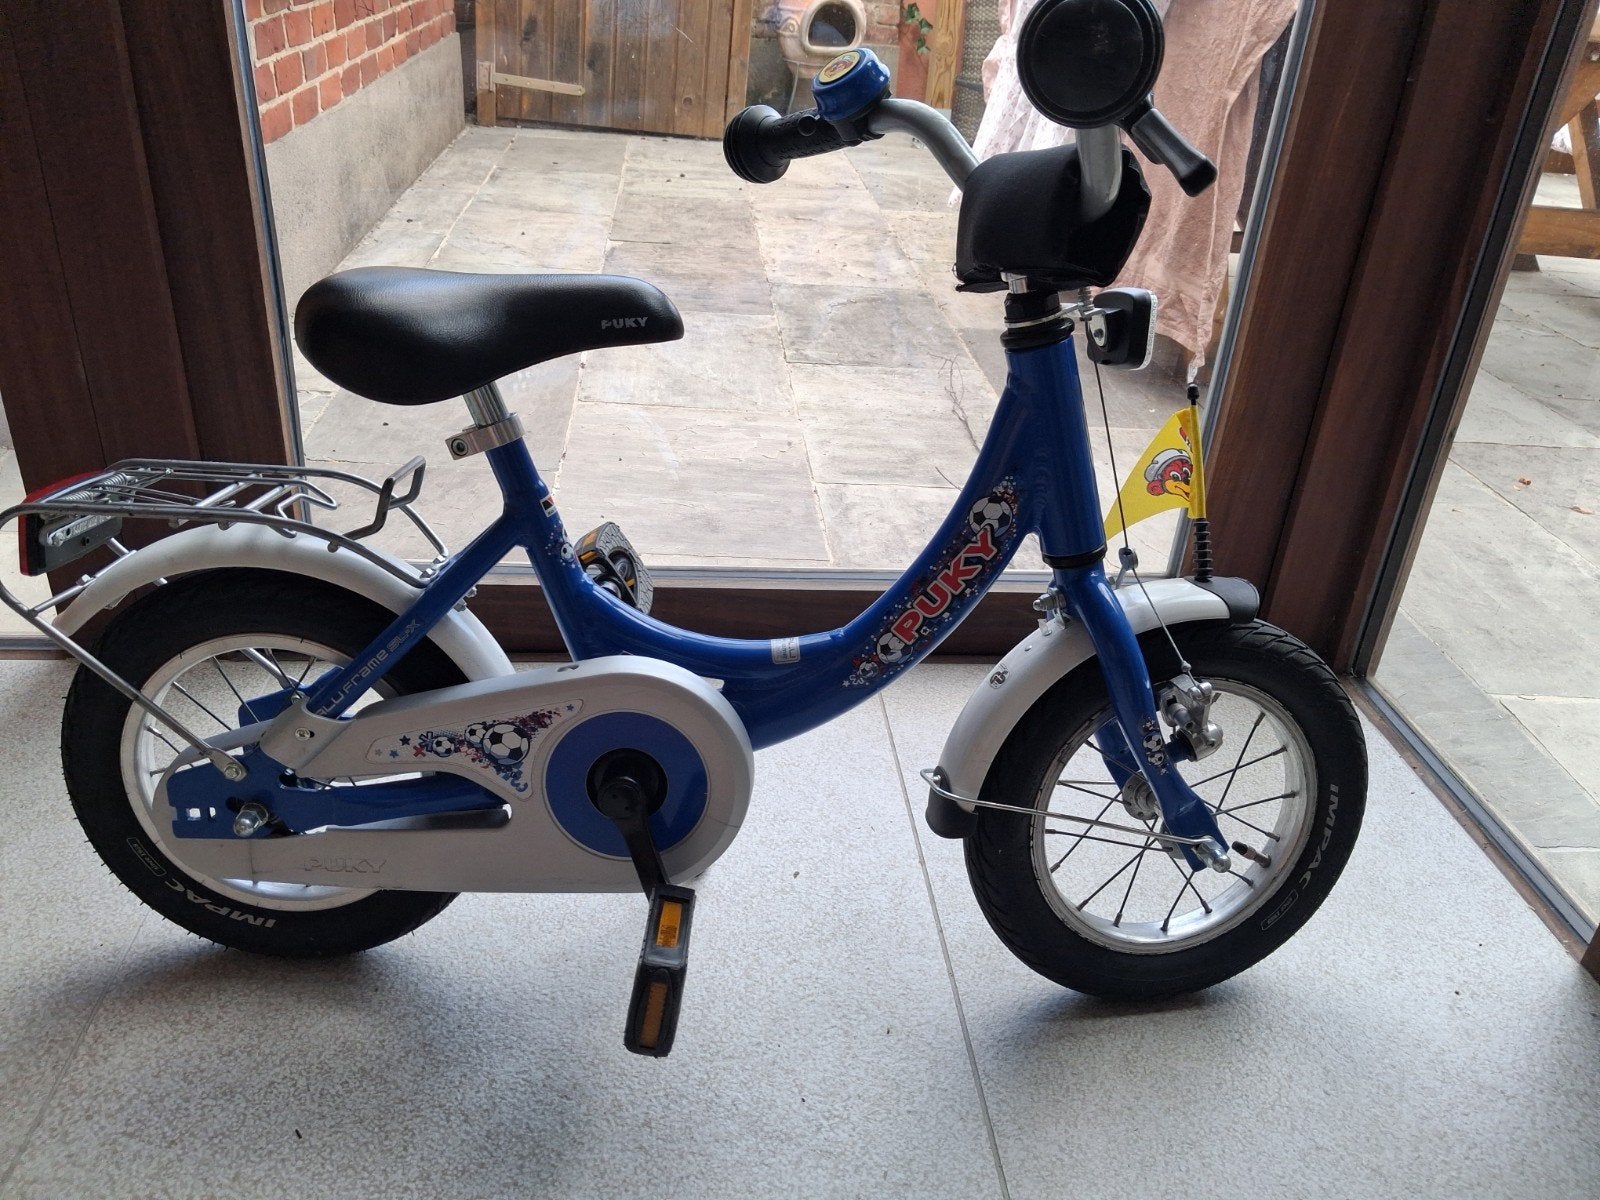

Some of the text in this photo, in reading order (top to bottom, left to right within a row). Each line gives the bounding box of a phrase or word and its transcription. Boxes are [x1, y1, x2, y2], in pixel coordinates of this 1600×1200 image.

[601, 316, 648, 330] PUKY
[890, 524, 998, 645] PUKY
[1298, 784, 1340, 890] IMPAC
[304, 857, 388, 874] PUKY
[165, 878, 277, 928] IMPAC
